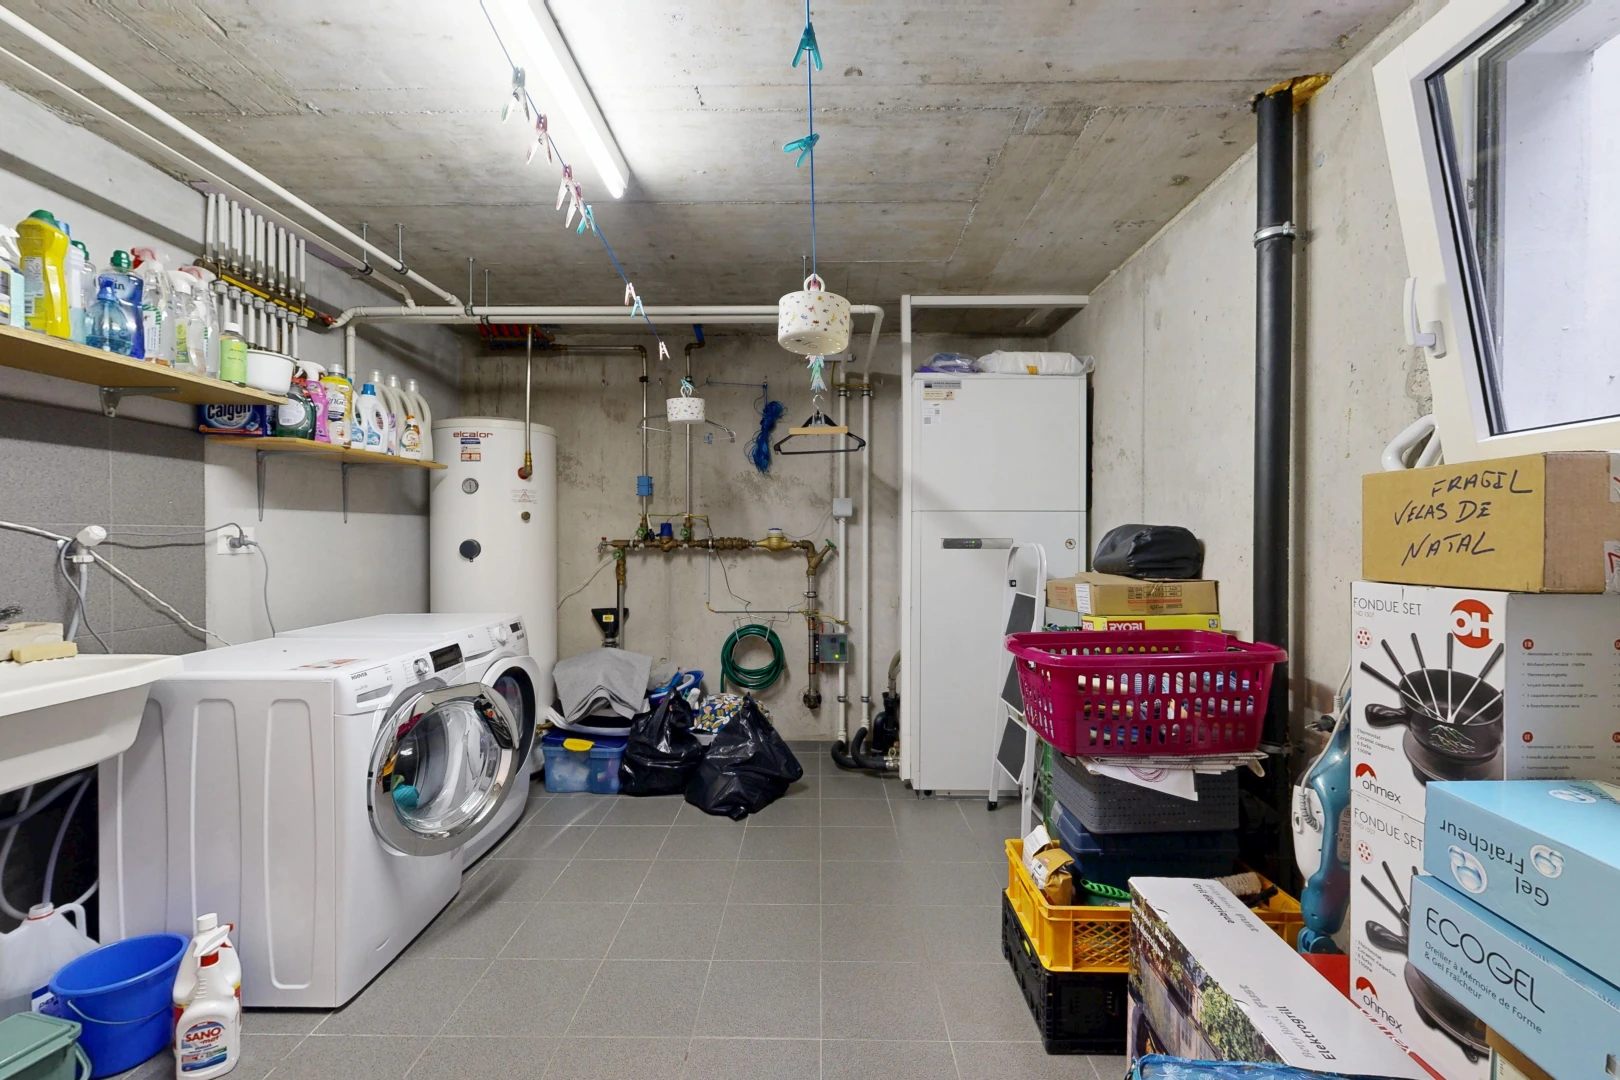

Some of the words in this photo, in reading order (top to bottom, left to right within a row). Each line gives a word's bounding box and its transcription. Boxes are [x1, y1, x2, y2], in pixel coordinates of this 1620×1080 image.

[453, 430, 493, 439] elcalor
[1431, 469, 1533, 497] FRAGIL
[1394, 500, 1448, 526] VELAS
[1455, 500, 1492, 523] DE
[1401, 531, 1495, 567] NATAL
[1353, 597, 1399, 614] FONDUE
[1402, 602, 1422, 616] SET
[1108, 622, 1144, 631] RYOBI
[1362, 780, 1402, 804] ohmex
[1354, 807, 1400, 841] FONDUE
[1403, 832, 1423, 852] SET
[1439, 819, 1525, 875] Fraîcheur
[1515, 876, 1550, 907] Gel
[1424, 951, 1430, 960] &
[1432, 957, 1444, 971] Gel
[1445, 966, 1482, 1000] Fraîcheur
[1426, 907, 1546, 1014] ECOGEL
[1425, 941, 1452, 966] Oreiller
[1453, 961, 1458, 971] à
[1460, 967, 1497, 1000] Mémoire
[1499, 997, 1510, 1010] de
[1512, 1006, 1543, 1035] Forme
[1362, 995, 1403, 1034] ohmex
[185, 1027, 221, 1043] SANO
[1276, 1006, 1338, 1061] Elektrogrill
